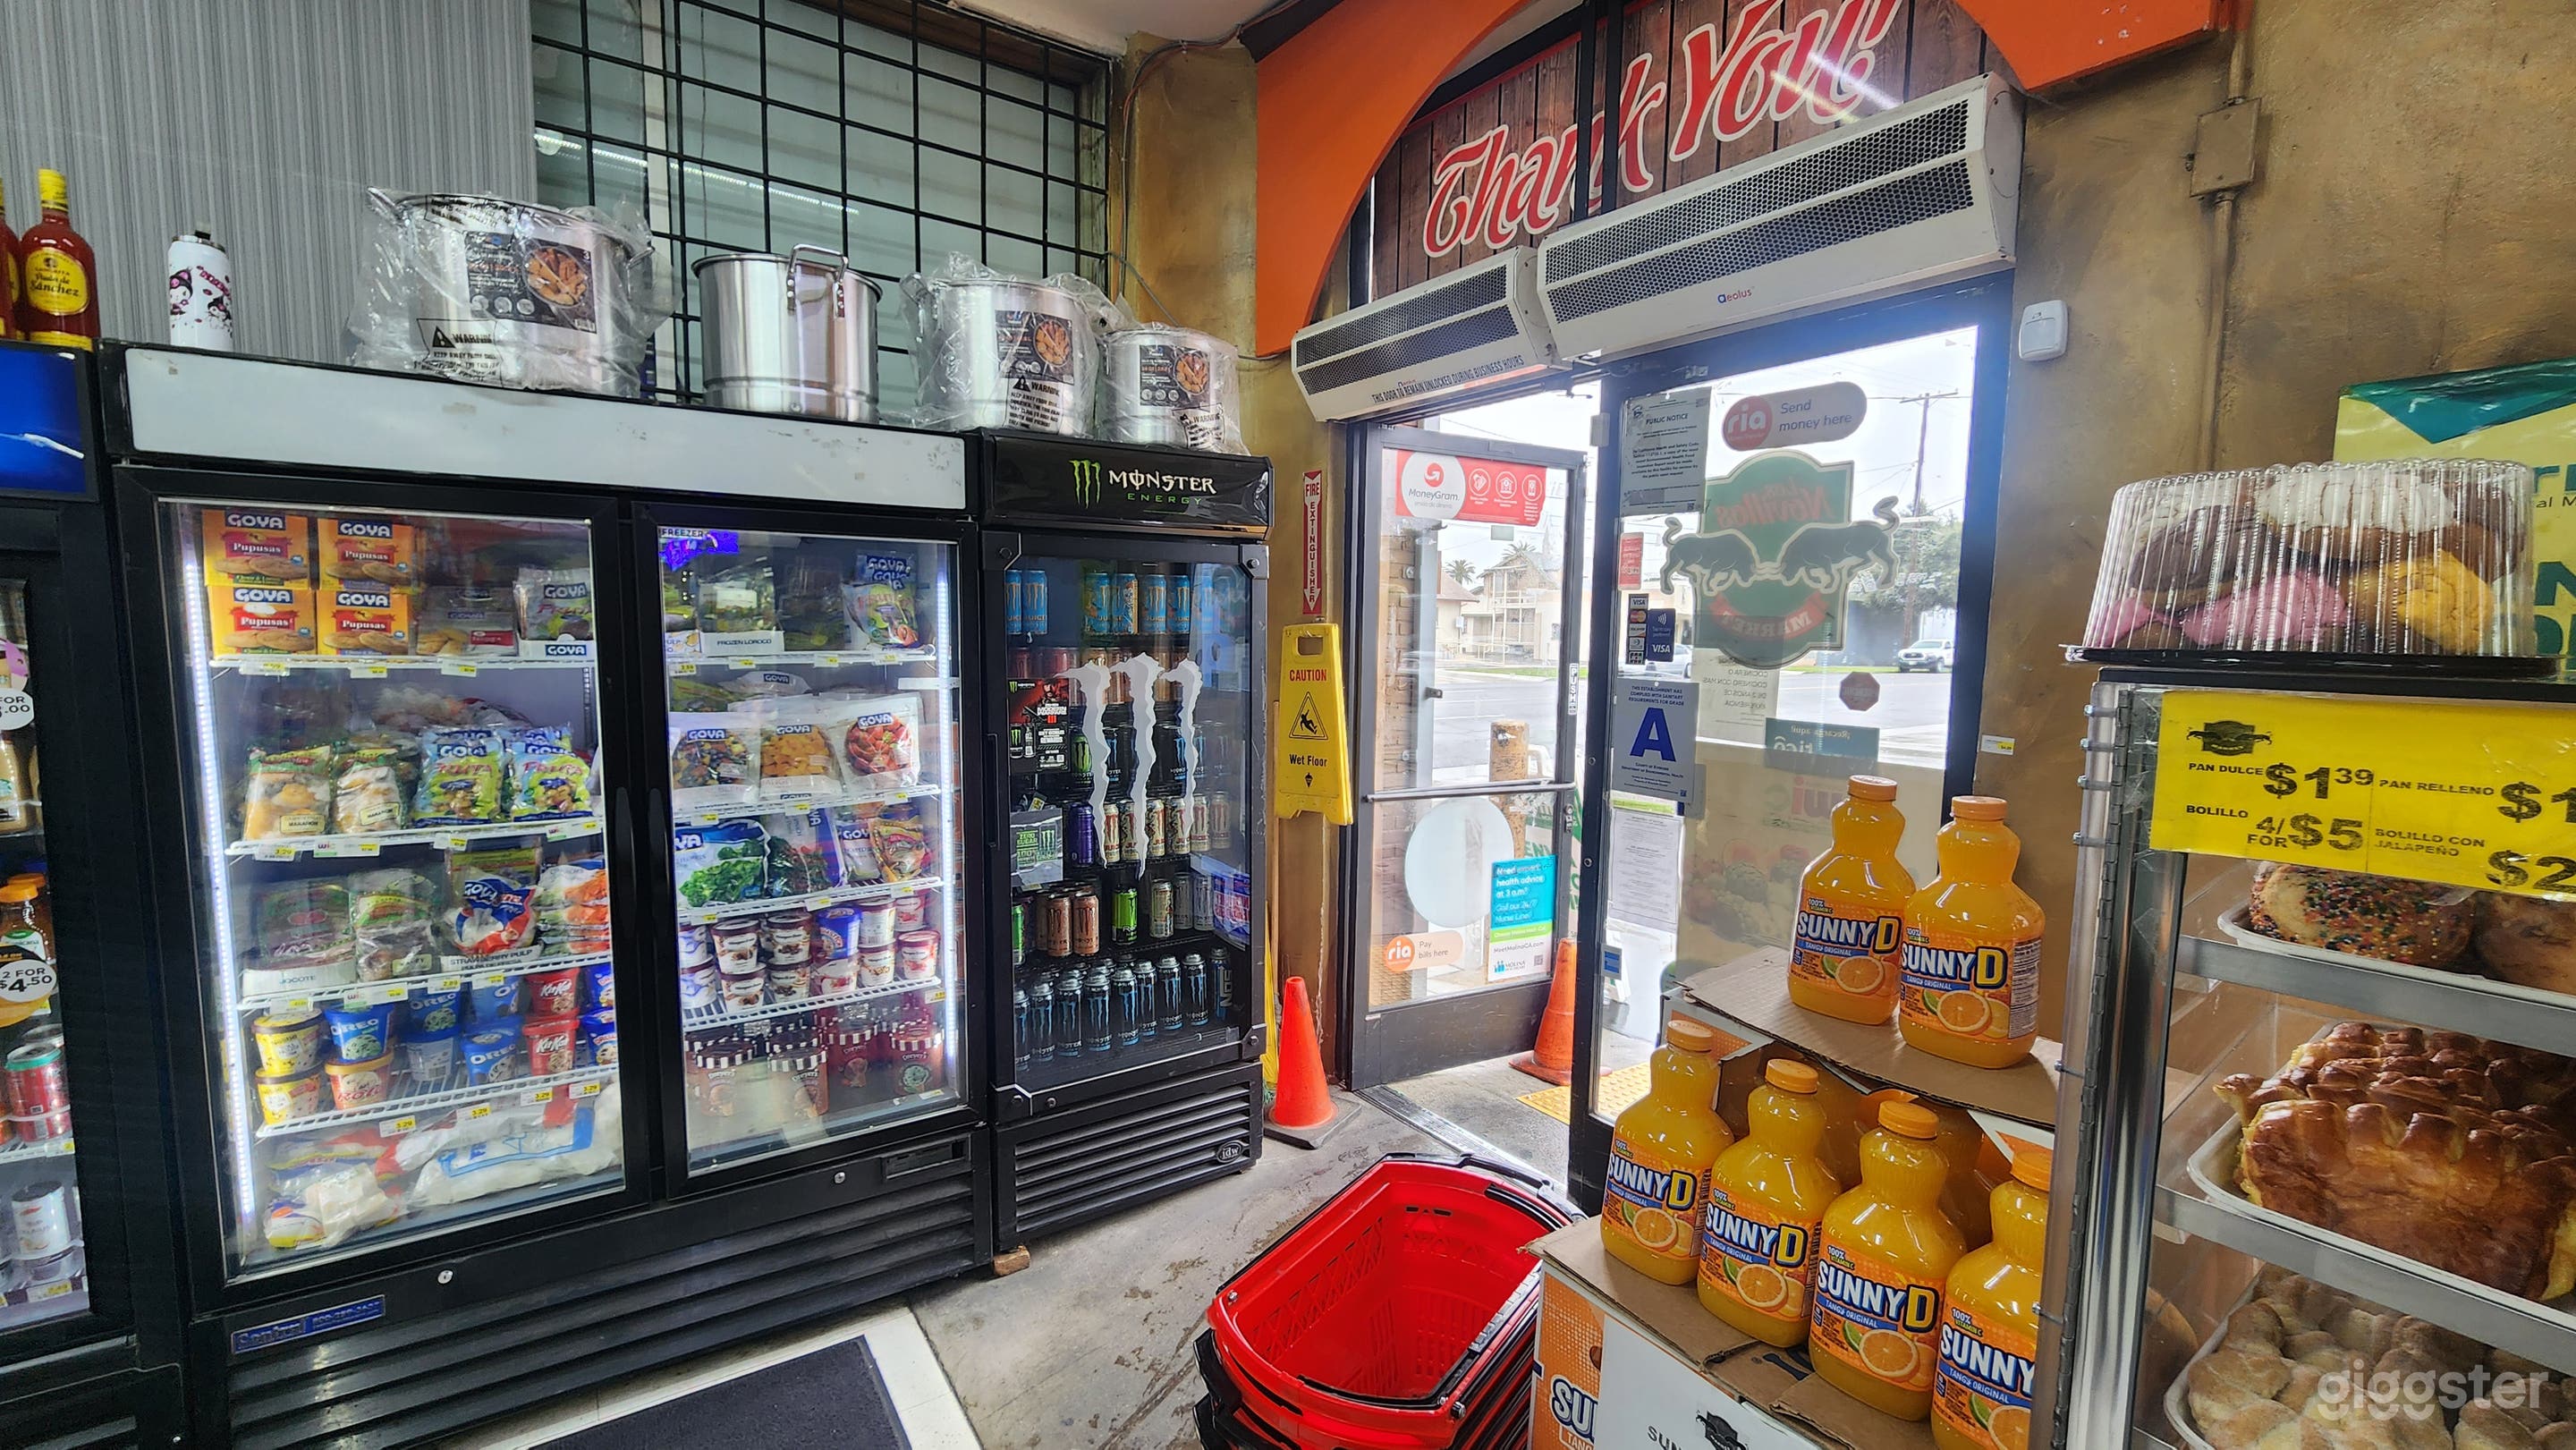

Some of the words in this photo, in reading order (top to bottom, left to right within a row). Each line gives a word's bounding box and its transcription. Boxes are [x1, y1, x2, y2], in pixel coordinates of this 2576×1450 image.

[1424, 53, 1666, 258] Thank
[30, 281, 80, 297] Sánchez
[1717, 287, 1752, 303] aeolus
[1404, 382, 1425, 396] REMAIN
[1425, 376, 1451, 391] UNLOCKED
[1453, 369, 1474, 383] DURING
[1781, 400, 1811, 414] Send
[1646, 416, 1665, 425] PUBLIC
[1666, 413, 1689, 422] NOTICE
[1727, 403, 1767, 435] ria
[1779, 418, 1818, 433] money
[1824, 412, 1852, 427] here
[1109, 470, 1216, 495] MONSTER
[1305, 483, 1319, 497] FIRE
[1128, 493, 1203, 505] ENERGY
[227, 513, 284, 530] GOYA
[341, 522, 391, 538] GOYA
[661, 529, 704, 538] FREEZER
[233, 542, 281, 555] Pupusas
[345, 550, 388, 561] Pupusas
[235, 588, 292, 604] GOYA
[545, 584, 586, 598] GOYA
[338, 593, 387, 607] GOYA
[241, 617, 289, 629] Pupusas
[342, 620, 386, 631] Pupusas
[716, 639, 744, 647] FROZEN
[1652, 644, 1671, 654] VISA
[547, 645, 586, 656] GOYA
[764, 674, 789, 683] GOYA
[1289, 669, 1327, 683] CAUTION
[860, 714, 893, 725] GOYA
[688, 729, 725, 740] GOYA
[776, 725, 811, 734] GOYA
[1630, 707, 1676, 762] A
[1289, 754, 1306, 767] Wet
[1307, 755, 1328, 767] Floor
[2189, 763, 2215, 772] PAN
[2219, 765, 2263, 776] DULCE
[2379, 779, 2411, 789] PAN
[2416, 783, 2495, 796] RELLENO
[2186, 805, 2249, 818] BOLILLO
[2247, 834, 2288, 848] FOR
[2375, 827, 2444, 844] BOLILLO
[2448, 836, 2486, 848] CON
[2375, 839, 2460, 857] JALAPEÑO
[1496, 878, 1519, 886] health
[1521, 876, 1544, 885] advice
[1796, 912, 1902, 954] SUNNYD
[1387, 940, 1411, 960] ria
[1419, 940, 1431, 949] Pay
[510, 949, 533, 958] PULP
[1419, 949, 1432, 960] bills
[1434, 949, 1449, 957] here
[16, 968, 46, 977] FOR
[1902, 942, 2008, 989] SUNNYD
[411, 993, 456, 1010] OREO
[331, 1019, 379, 1036] OREO
[1222, 1146, 1240, 1160] idw
[1705, 1202, 1809, 1268] SUNNYD
[1726, 1246, 1753, 1263] ORIGINAL
[1818, 1259, 1939, 1333] SUNNYD
[1845, 1310, 1878, 1328] ORIGINAL
[1952, 1308, 1972, 1324] 100%
[1940, 1322, 2036, 1397] SUNNY
[1949, 1368, 1971, 1386] TANGY
[1973, 1379, 2011, 1403] ORIGINAL
